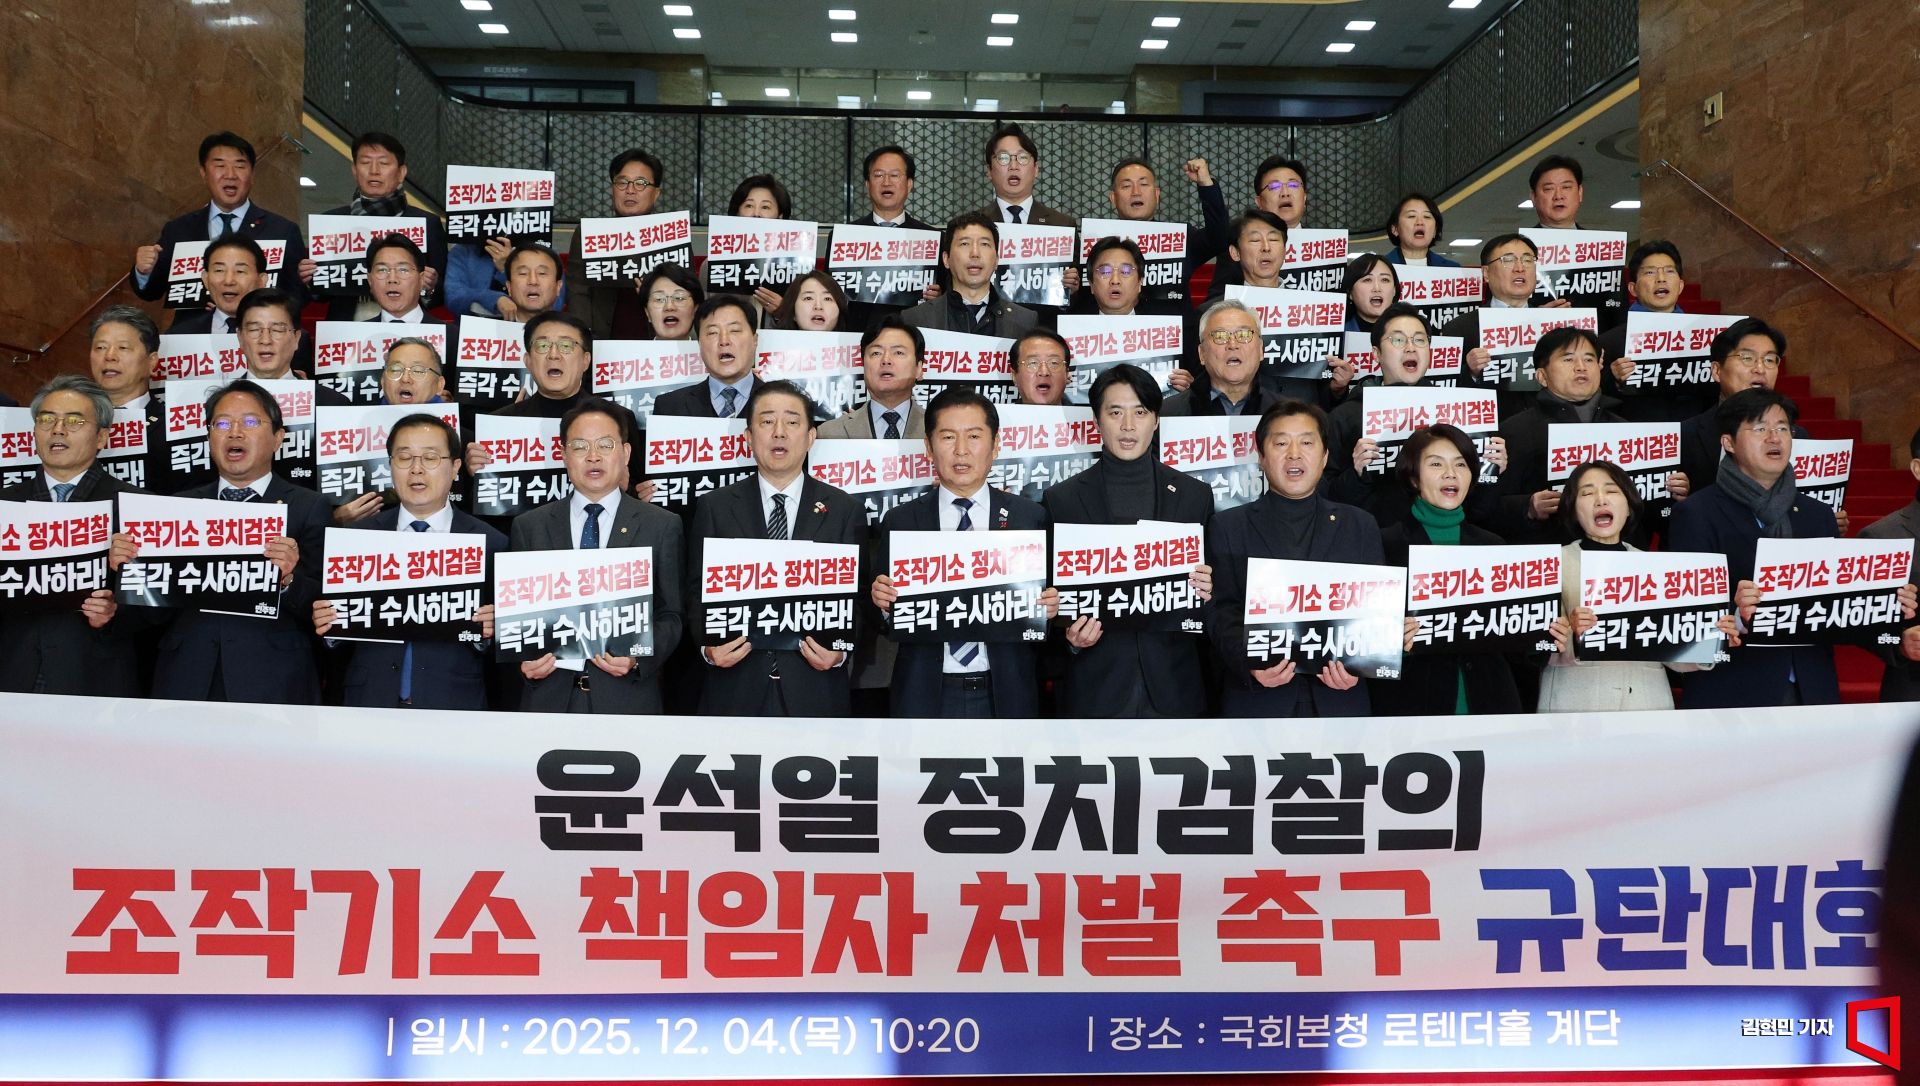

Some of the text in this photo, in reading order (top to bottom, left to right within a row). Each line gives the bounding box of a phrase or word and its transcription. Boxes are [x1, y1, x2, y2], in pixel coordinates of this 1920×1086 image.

[449, 180, 552, 205] 조작기소 정치검찰
[448, 215, 479, 237] 즉각
[483, 210, 550, 236] 수사하라!
[584, 219, 689, 253] 조작기소 정치검찰
[312, 231, 366, 256] 조작기소
[711, 233, 760, 254] 조작기소
[832, 239, 938, 262] 조작기소 정치검찰
[1021, 236, 1073, 257] 정치검찰
[1137, 232, 1185, 255] 정치검찰
[1302, 238, 1347, 260] 정치검찰
[1575, 239, 1624, 262] 정치검찰
[172, 256, 206, 276] 조작
[313, 264, 347, 288] 즉각
[585, 261, 618, 281] 즉각
[710, 264, 741, 286] 즉각
[168, 281, 203, 303] 즉각
[1431, 276, 1482, 299] 정치검찰
[1555, 270, 1621, 295] 수사하라!
[1287, 303, 1344, 327] 정치검찰
[461, 338, 522, 361] 조작기소
[1123, 325, 1181, 350] 정치검찰
[1264, 337, 1340, 364] 수사하라!
[1482, 325, 1536, 349] 조작기소
[1629, 328, 1728, 354] 조작기소 정치
[219, 348, 249, 374] 정치
[318, 340, 377, 367] 조작기소
[977, 350, 1012, 373] 정치
[1430, 347, 1461, 369] 검찰
[595, 351, 709, 385] 조작기소 정치검
[1483, 357, 1517, 384] 즉각
[1626, 360, 1715, 388] 즉각 수사하
[458, 372, 497, 397] 즉각
[1366, 399, 1495, 435] 조작기소 정치검찰
[1, 420, 144, 458] 조작 검찰
[320, 425, 387, 456] 조작기소
[1000, 418, 1102, 451] 작기소 정치검
[1619, 433, 1679, 464] 정치검찰
[171, 440, 210, 472] 즉각
[480, 437, 545, 465] 조작기소
[649, 433, 752, 466] 조작기소 정치
[1163, 436, 1226, 465] 조작기소
[987, 464, 1025, 495] 즉각
[1794, 451, 1850, 480] 정치검찰
[320, 467, 365, 497] 즉각
[477, 480, 521, 506] 즉각
[650, 478, 690, 505] 즉각
[28, 513, 109, 550] 정치검찰
[123, 517, 284, 548] 조작기소 정치검찰
[327, 547, 483, 584] 조작기소 정치검찰
[893, 553, 963, 587] 조작기소
[1057, 535, 1200, 577] 조작기소 정치검찰
[0, 557, 107, 597] 수사하라!
[120, 560, 278, 595] 즉각 수사하라!
[498, 559, 650, 609] 조작기소 정치검찰
[705, 556, 857, 594] 조작기소 정치검찰
[1412, 556, 1559, 602] 조작기소 정치검찰
[1664, 566, 1728, 600] 정치검찰
[1759, 551, 1910, 593] 조작기소 정치검찰
[254, 604, 276, 615] 민주당
[331, 589, 480, 629] 즉각 수사하라!
[893, 587, 1043, 633] 즉각 수사하라!
[1059, 579, 1201, 620] 즉각 수사하라!
[499, 601, 649, 653] 즉각 수사하라!
[705, 599, 853, 639] 즉각 수사하라!
[1181, 621, 1203, 630] 민주당
[1413, 612, 1455, 645] 즉각
[1462, 599, 1558, 640] 수사하라!
[1752, 593, 1901, 637] 즉각 수사하라!
[458, 633, 481, 643] 민주당
[832, 641, 854, 651] 민주당
[1023, 630, 1045, 640] 민주당
[1247, 627, 1294, 662] 즉각
[1584, 618, 1630, 651] 즉각
[629, 646, 652, 656] 민주당
[1376, 668, 1400, 678] 민주당
[534, 749, 1486, 855] 윤석열 정치검찰의
[66, 867, 540, 979] 조작기소
[578, 867, 929, 979] 책임자
[956, 870, 1183, 978] 처벌
[1220, 868, 1441, 977] 촉구
[411, 1018, 484, 1055] 일시
[523, 1018, 640, 1055] 2025.
[657, 1018, 708, 1055] 12.
[723, 1017, 857, 1058] 04.(목)
[874, 1018, 980, 1054] 10:20
[1109, 1017, 1183, 1050] 장소
[1219, 1013, 1369, 1049] 국회본청
[1382, 1010, 1533, 1047] 로텐더홀
[1545, 1009, 1621, 1047] 계단
